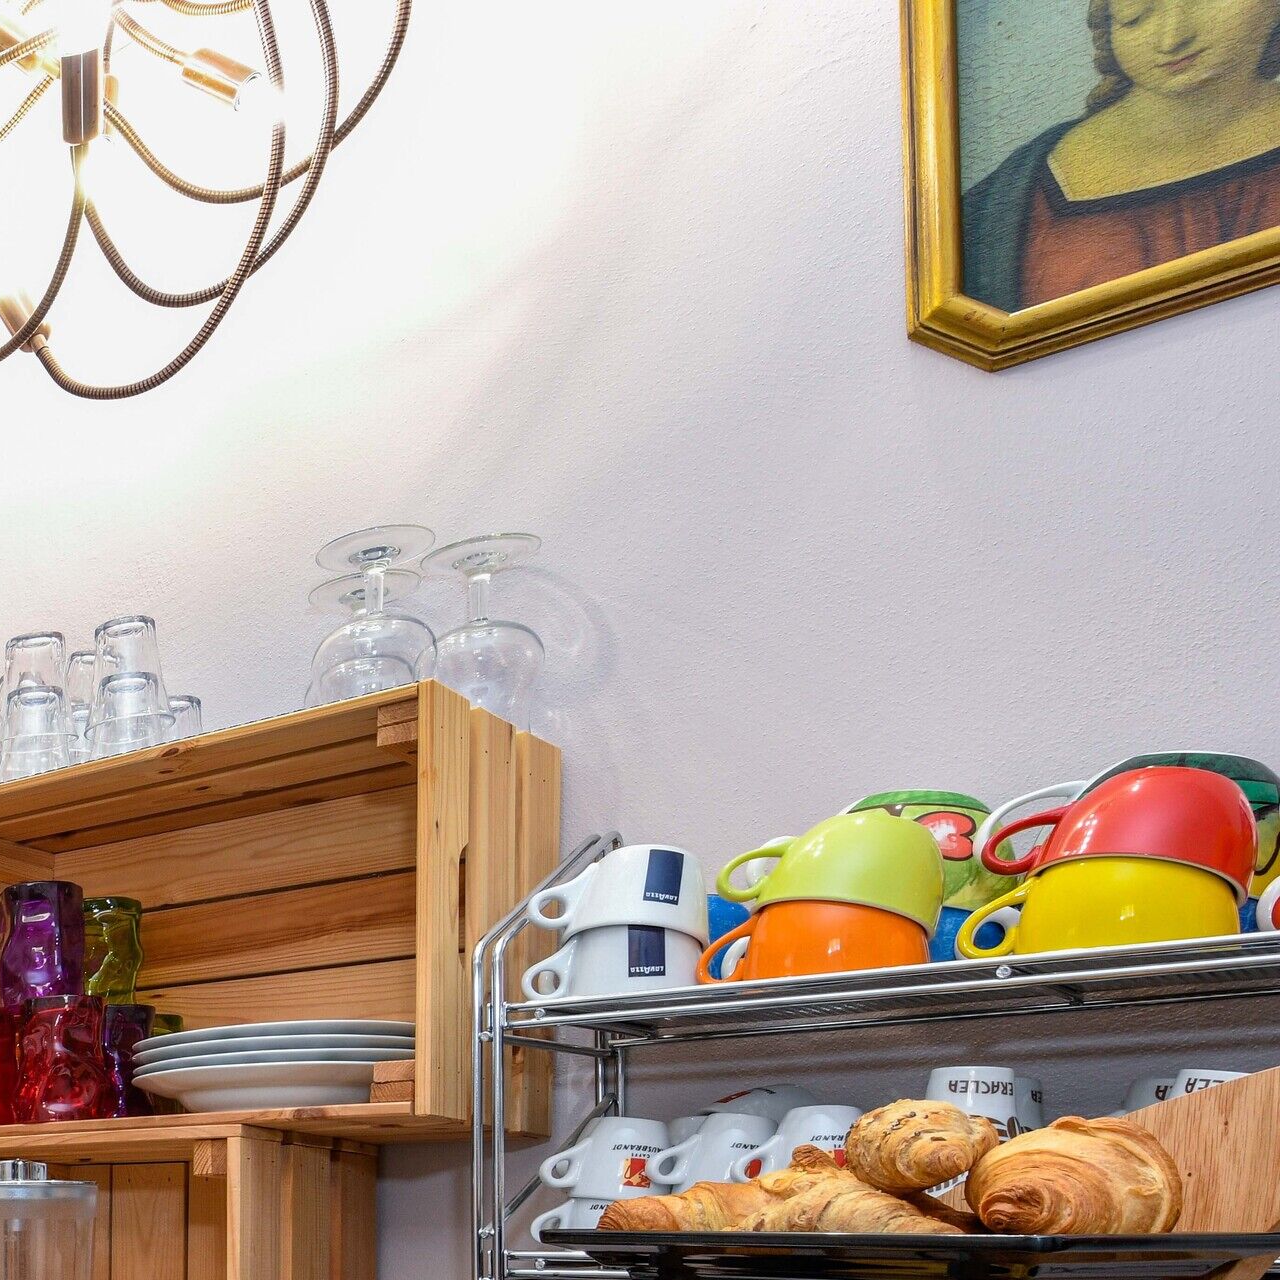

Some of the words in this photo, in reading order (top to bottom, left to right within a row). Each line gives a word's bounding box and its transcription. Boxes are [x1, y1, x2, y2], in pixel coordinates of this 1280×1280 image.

[645, 891, 678, 901] LAVAZZA
[630, 965, 664, 974] LAVAZZA
[948, 1079, 1014, 1097] ERACLEA
[810, 1134, 847, 1143] RANDT
[611, 1143, 665, 1155] AUSBRANDT
